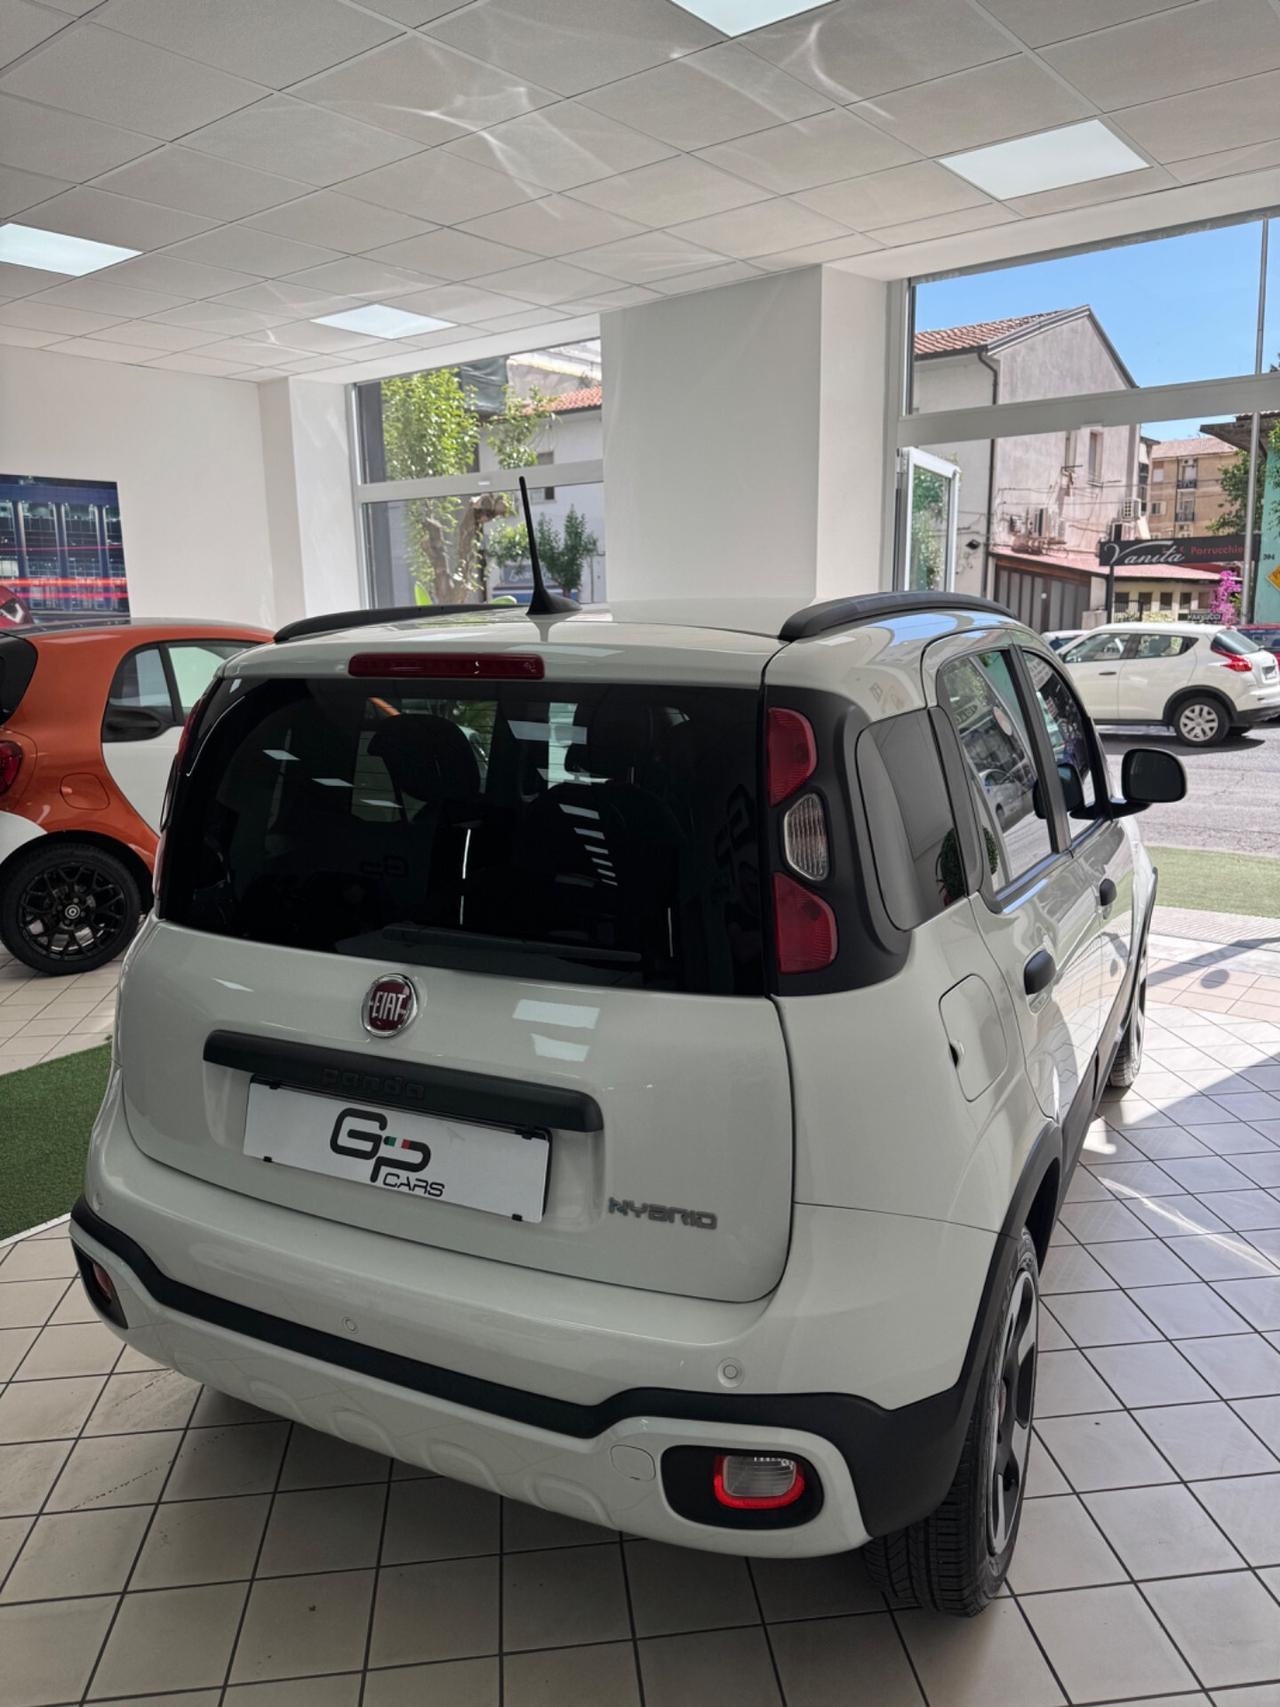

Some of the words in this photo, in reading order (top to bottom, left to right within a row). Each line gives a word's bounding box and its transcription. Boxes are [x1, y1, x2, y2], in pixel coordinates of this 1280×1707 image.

[371, 991, 407, 1021] FIAT
[330, 1107, 431, 1183] GP
[382, 1172, 445, 1197] CARS
